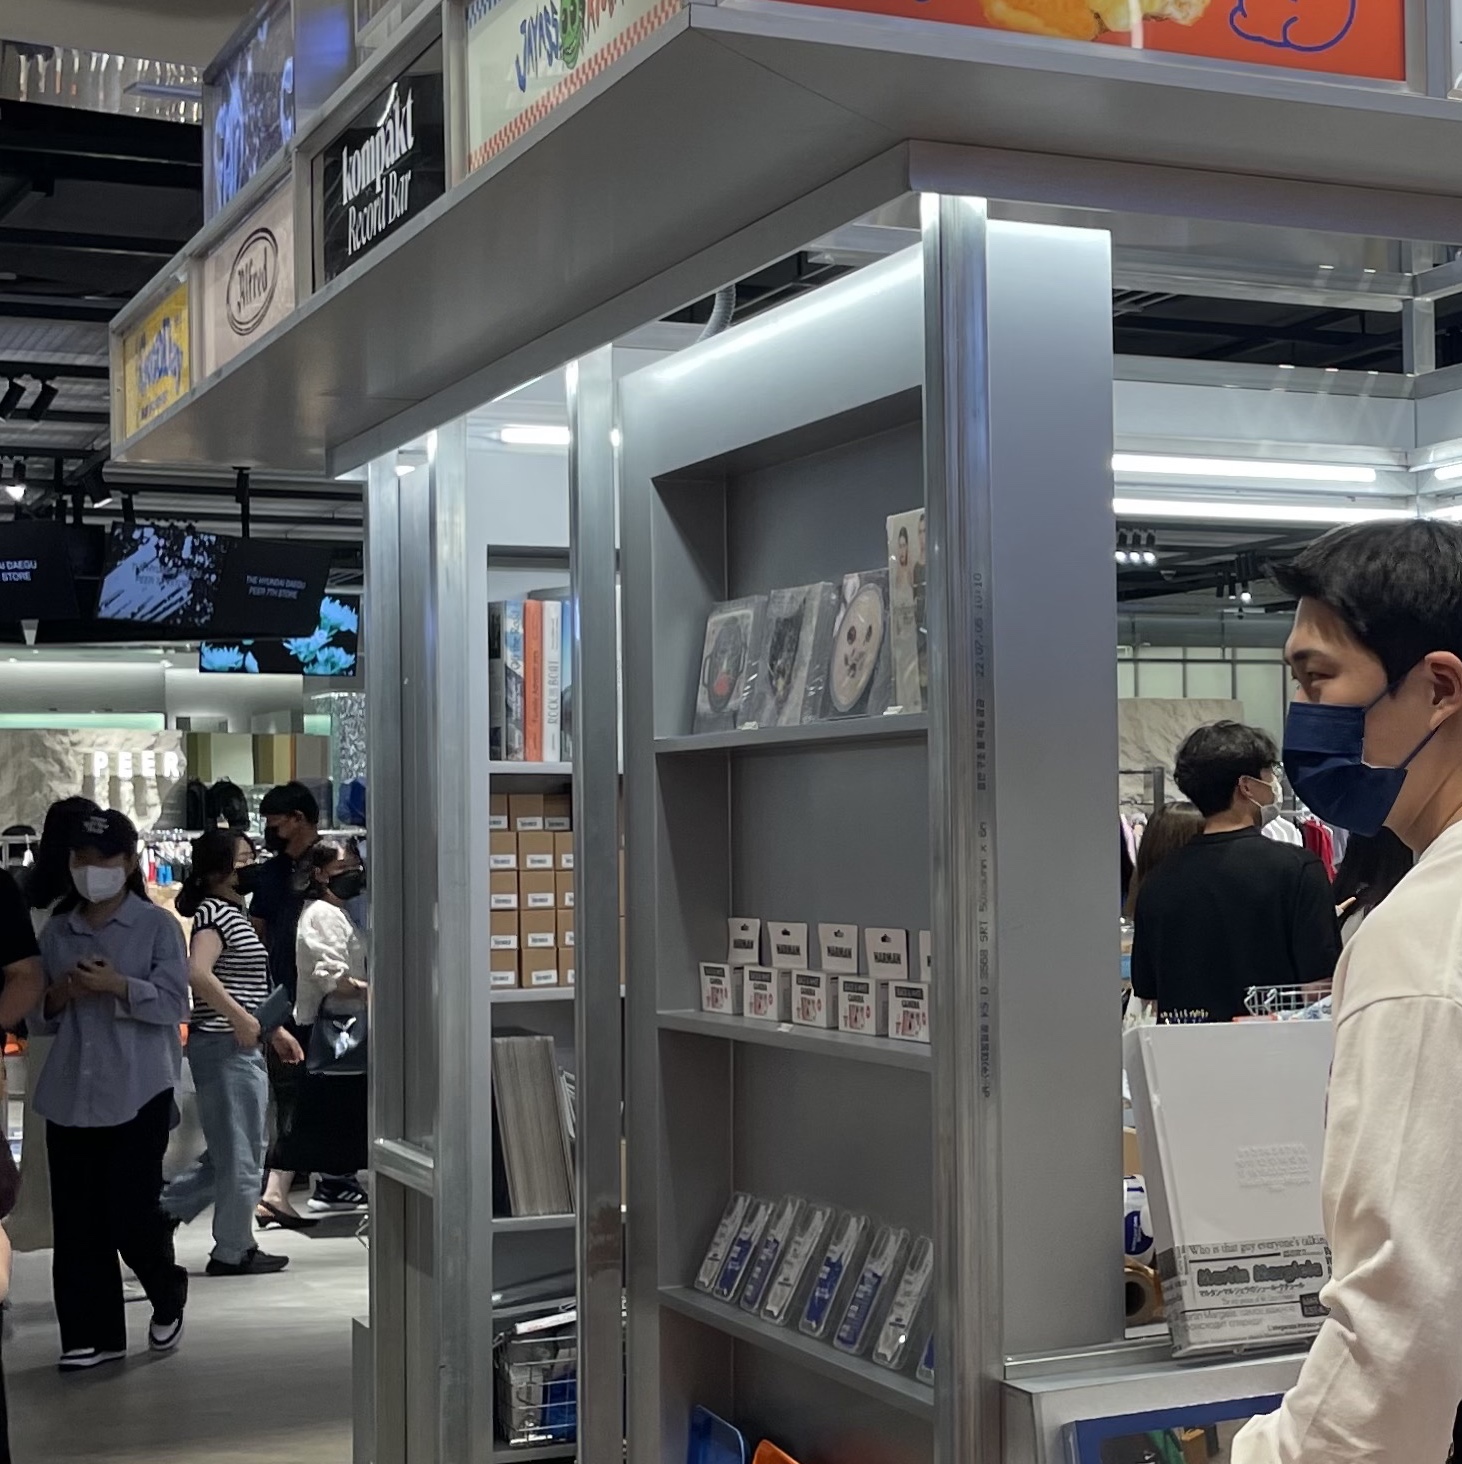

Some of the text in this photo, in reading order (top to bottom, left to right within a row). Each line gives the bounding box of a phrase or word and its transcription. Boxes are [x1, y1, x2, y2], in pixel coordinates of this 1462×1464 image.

[341, 86, 414, 205] kompakt
[348, 170, 412, 256] Record Bar
[7, 559, 38, 571] DAEGU
[94, 751, 180, 778] PEER
[1189, 1243, 1210, 1255] Who
